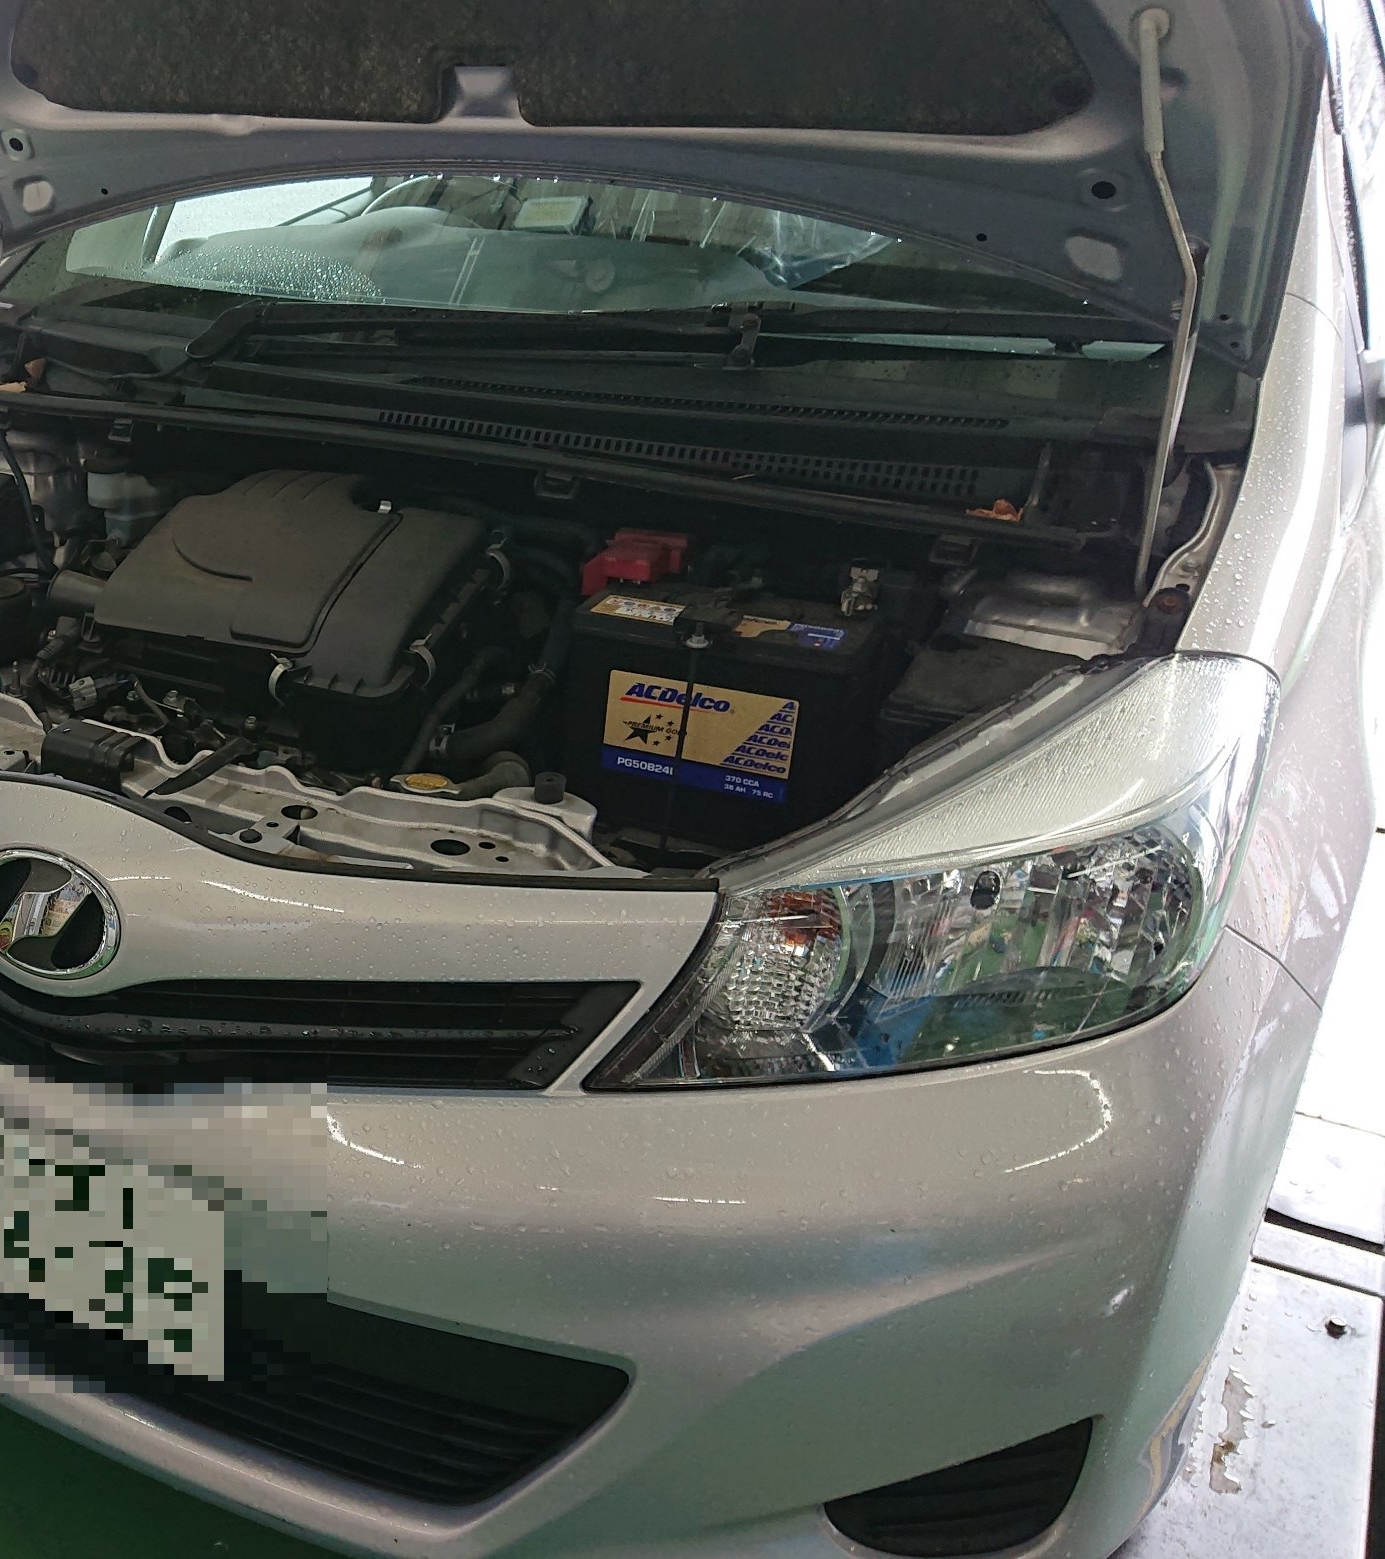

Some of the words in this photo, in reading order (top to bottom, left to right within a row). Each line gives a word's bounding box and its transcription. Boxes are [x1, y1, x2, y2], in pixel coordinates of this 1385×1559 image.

[626, 683, 731, 713] ACDelco
[627, 720, 664, 733] PREMIUM
[723, 755, 786, 773] ACDelco
[743, 778, 759, 787] CCA
